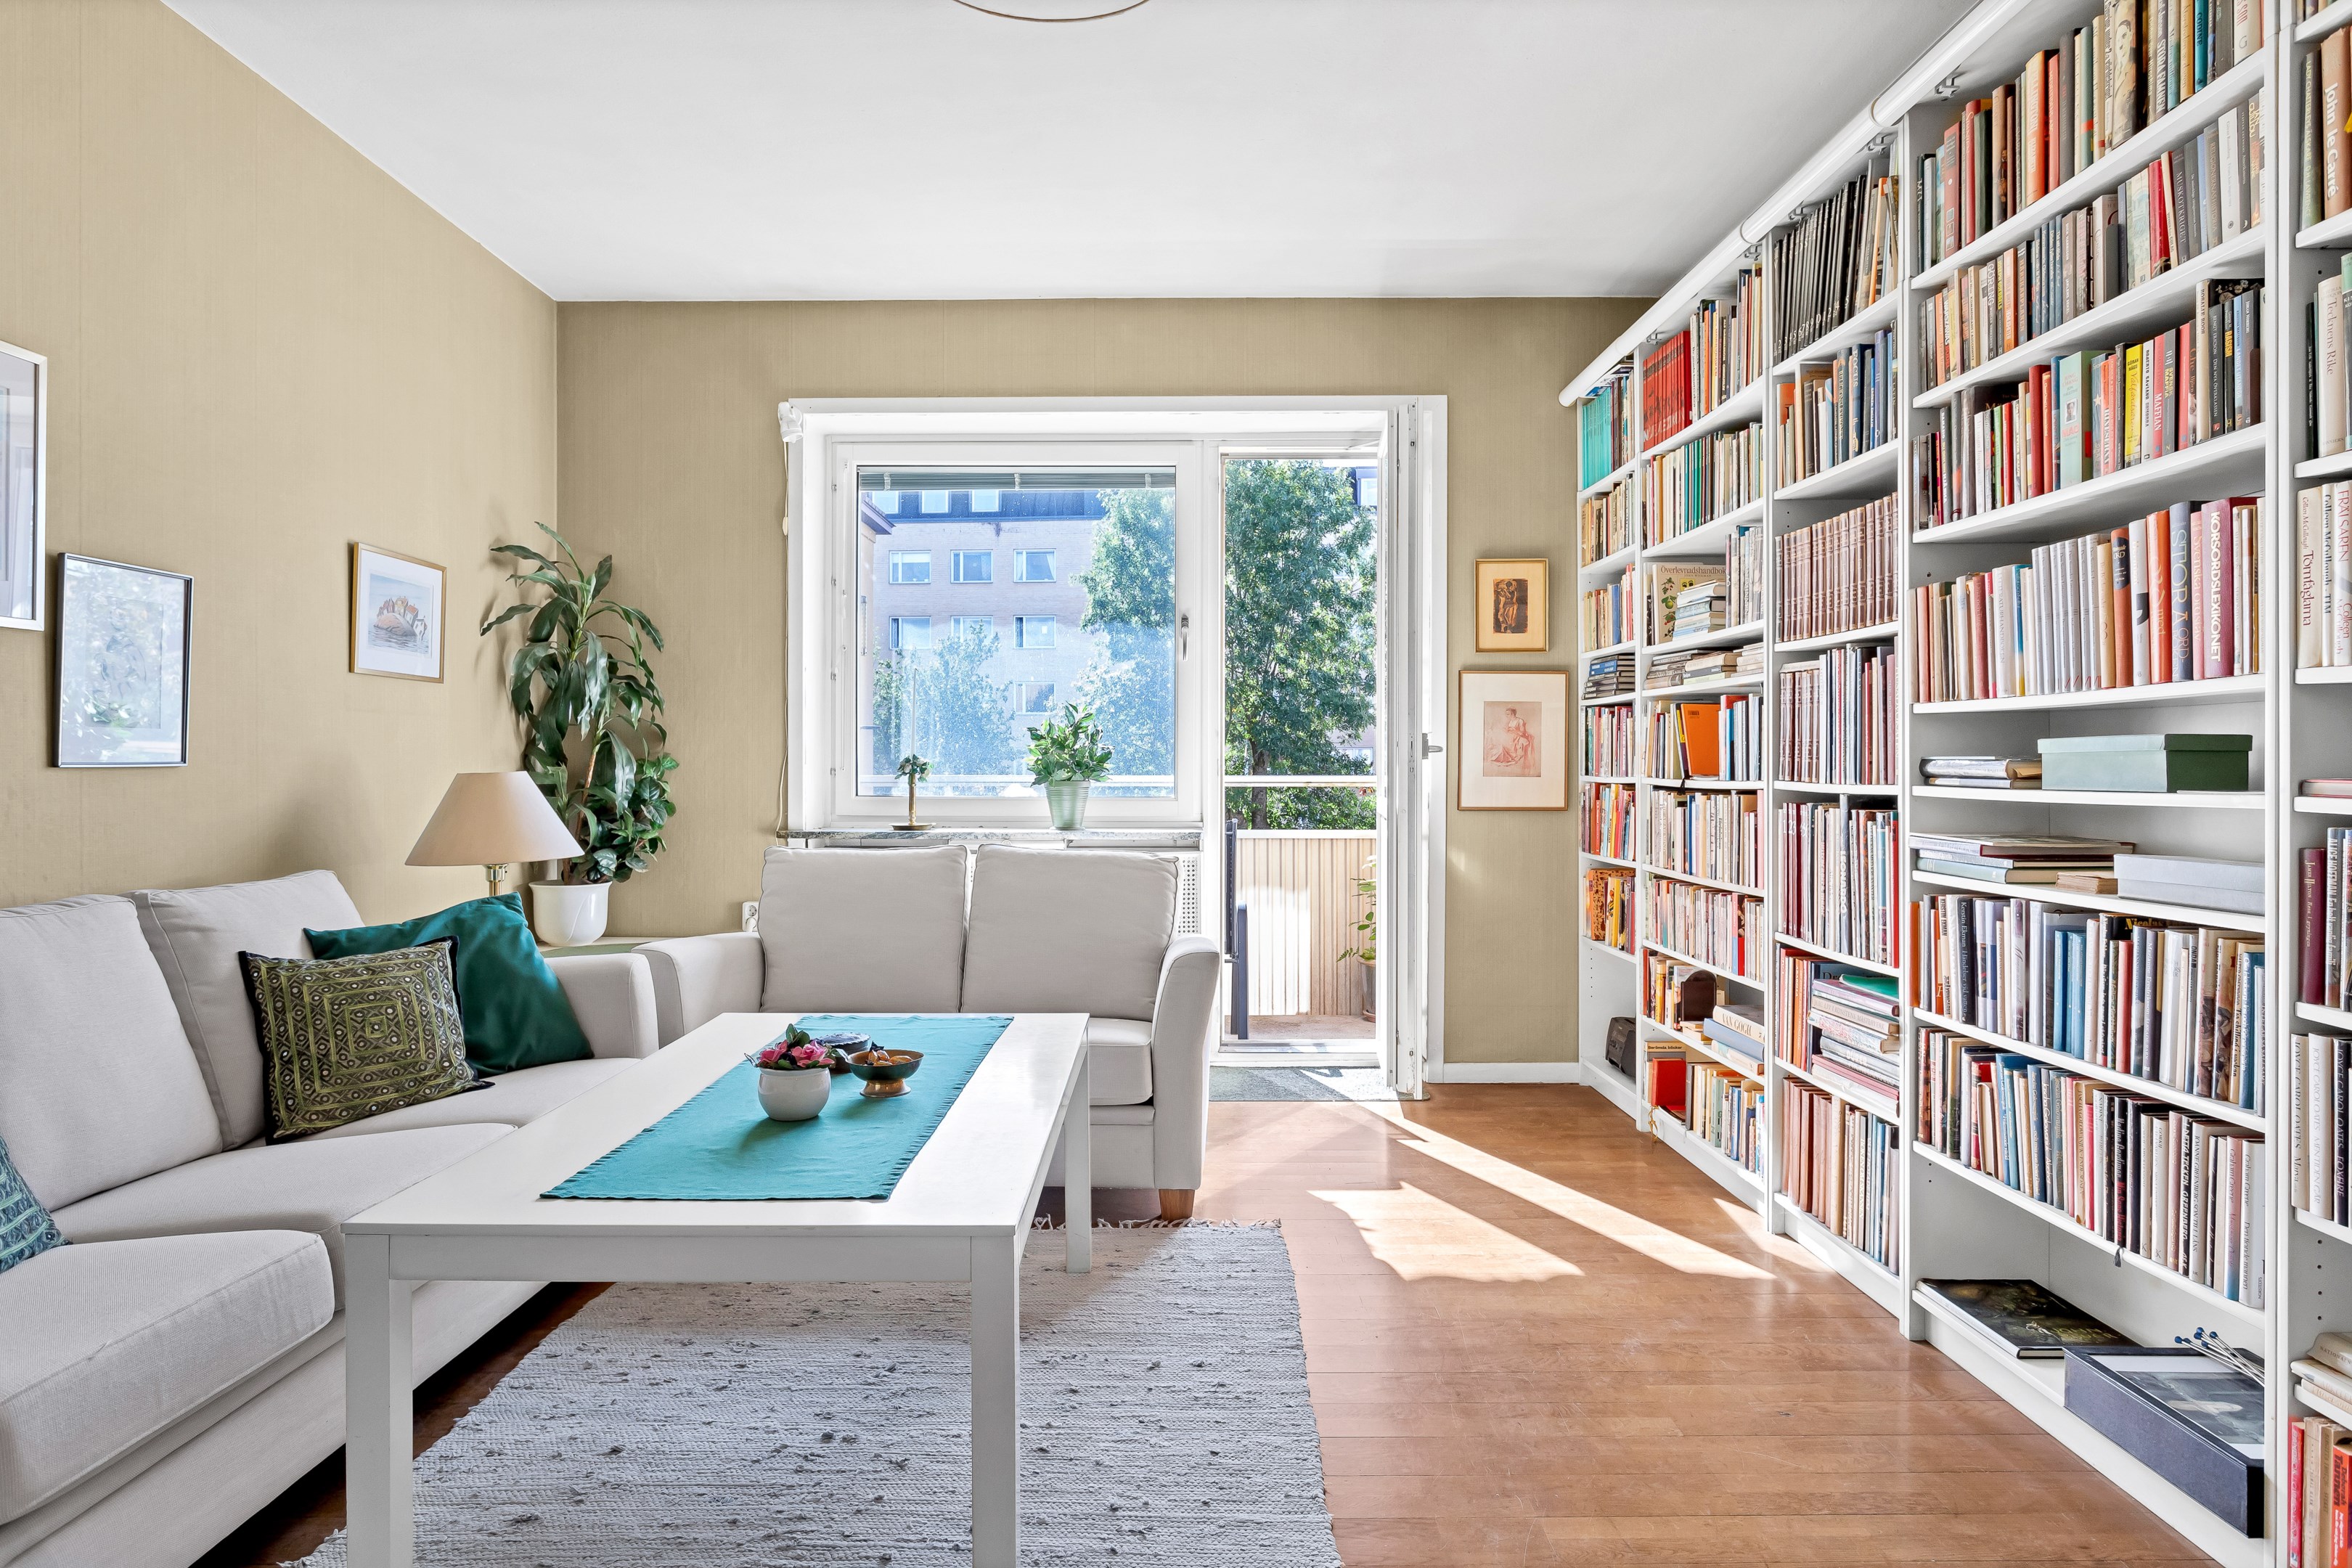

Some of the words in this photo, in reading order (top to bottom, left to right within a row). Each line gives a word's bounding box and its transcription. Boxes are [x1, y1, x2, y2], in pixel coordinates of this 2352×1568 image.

[2157, 39, 2166, 70] STORA
[2156, 71, 2165, 113] FAMNEN
[2324, 83, 2338, 125] John
[2327, 128, 2338, 148] le
[2327, 150, 2339, 197] Carré
[2176, 171, 2187, 243] MUSKOTKRIGET
[1805, 322, 1810, 332] 8
[1810, 318, 1814, 328] 9
[2326, 298, 2337, 349] Tecknens
[2326, 351, 2337, 376] Rike
[2154, 393, 2163, 431] MAFFIAN
[2062, 424, 2079, 438] MAO
[2300, 515, 2309, 550] McCullough
[1661, 565, 1726, 574] Överlevnadshandbok
[2171, 528, 2189, 626] STORA
[2193, 536, 2203, 589] Svenska
[2210, 511, 2221, 662] KORSORDSLEXIKONET
[2300, 550, 2315, 626] Törnfåglarna
[2343, 603, 2352, 639] Colleen
[2328, 838, 2338, 860] ALICE
[2304, 860, 2316, 878] JAMES
[2327, 860, 2337, 895] HOFFMAN
[1722, 1013, 1734, 1026] VAN
[1734, 1019, 1752, 1036] GOGH
[2116, 1118, 2125, 1142] Nadine
[2334, 1455, 2343, 1506] Tannen
